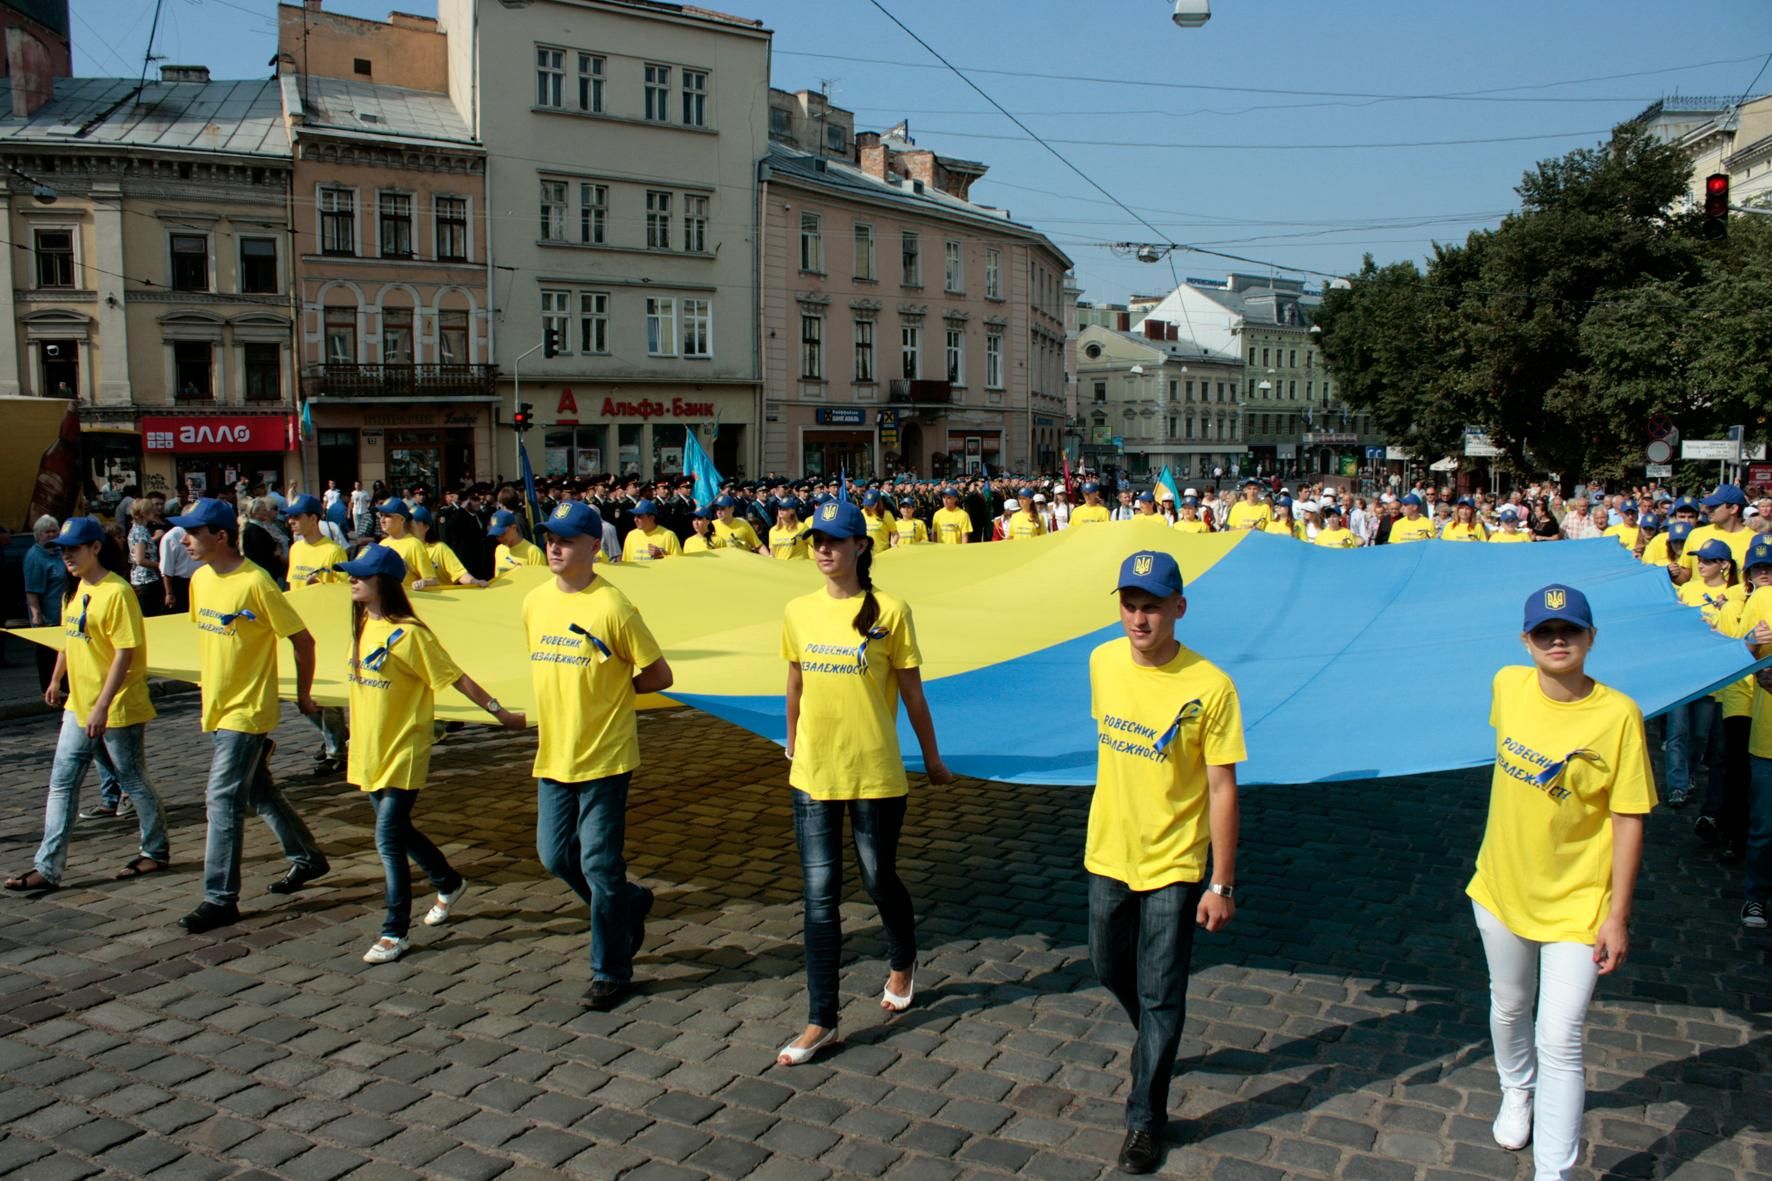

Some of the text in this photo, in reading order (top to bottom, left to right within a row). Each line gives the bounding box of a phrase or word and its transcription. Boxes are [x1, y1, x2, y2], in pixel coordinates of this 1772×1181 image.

[540, 635, 582, 648] РОВЕСНИК
[805, 643, 857, 657] РОВЕСНИК
[1103, 714, 1158, 741] РОВЕСНИК
